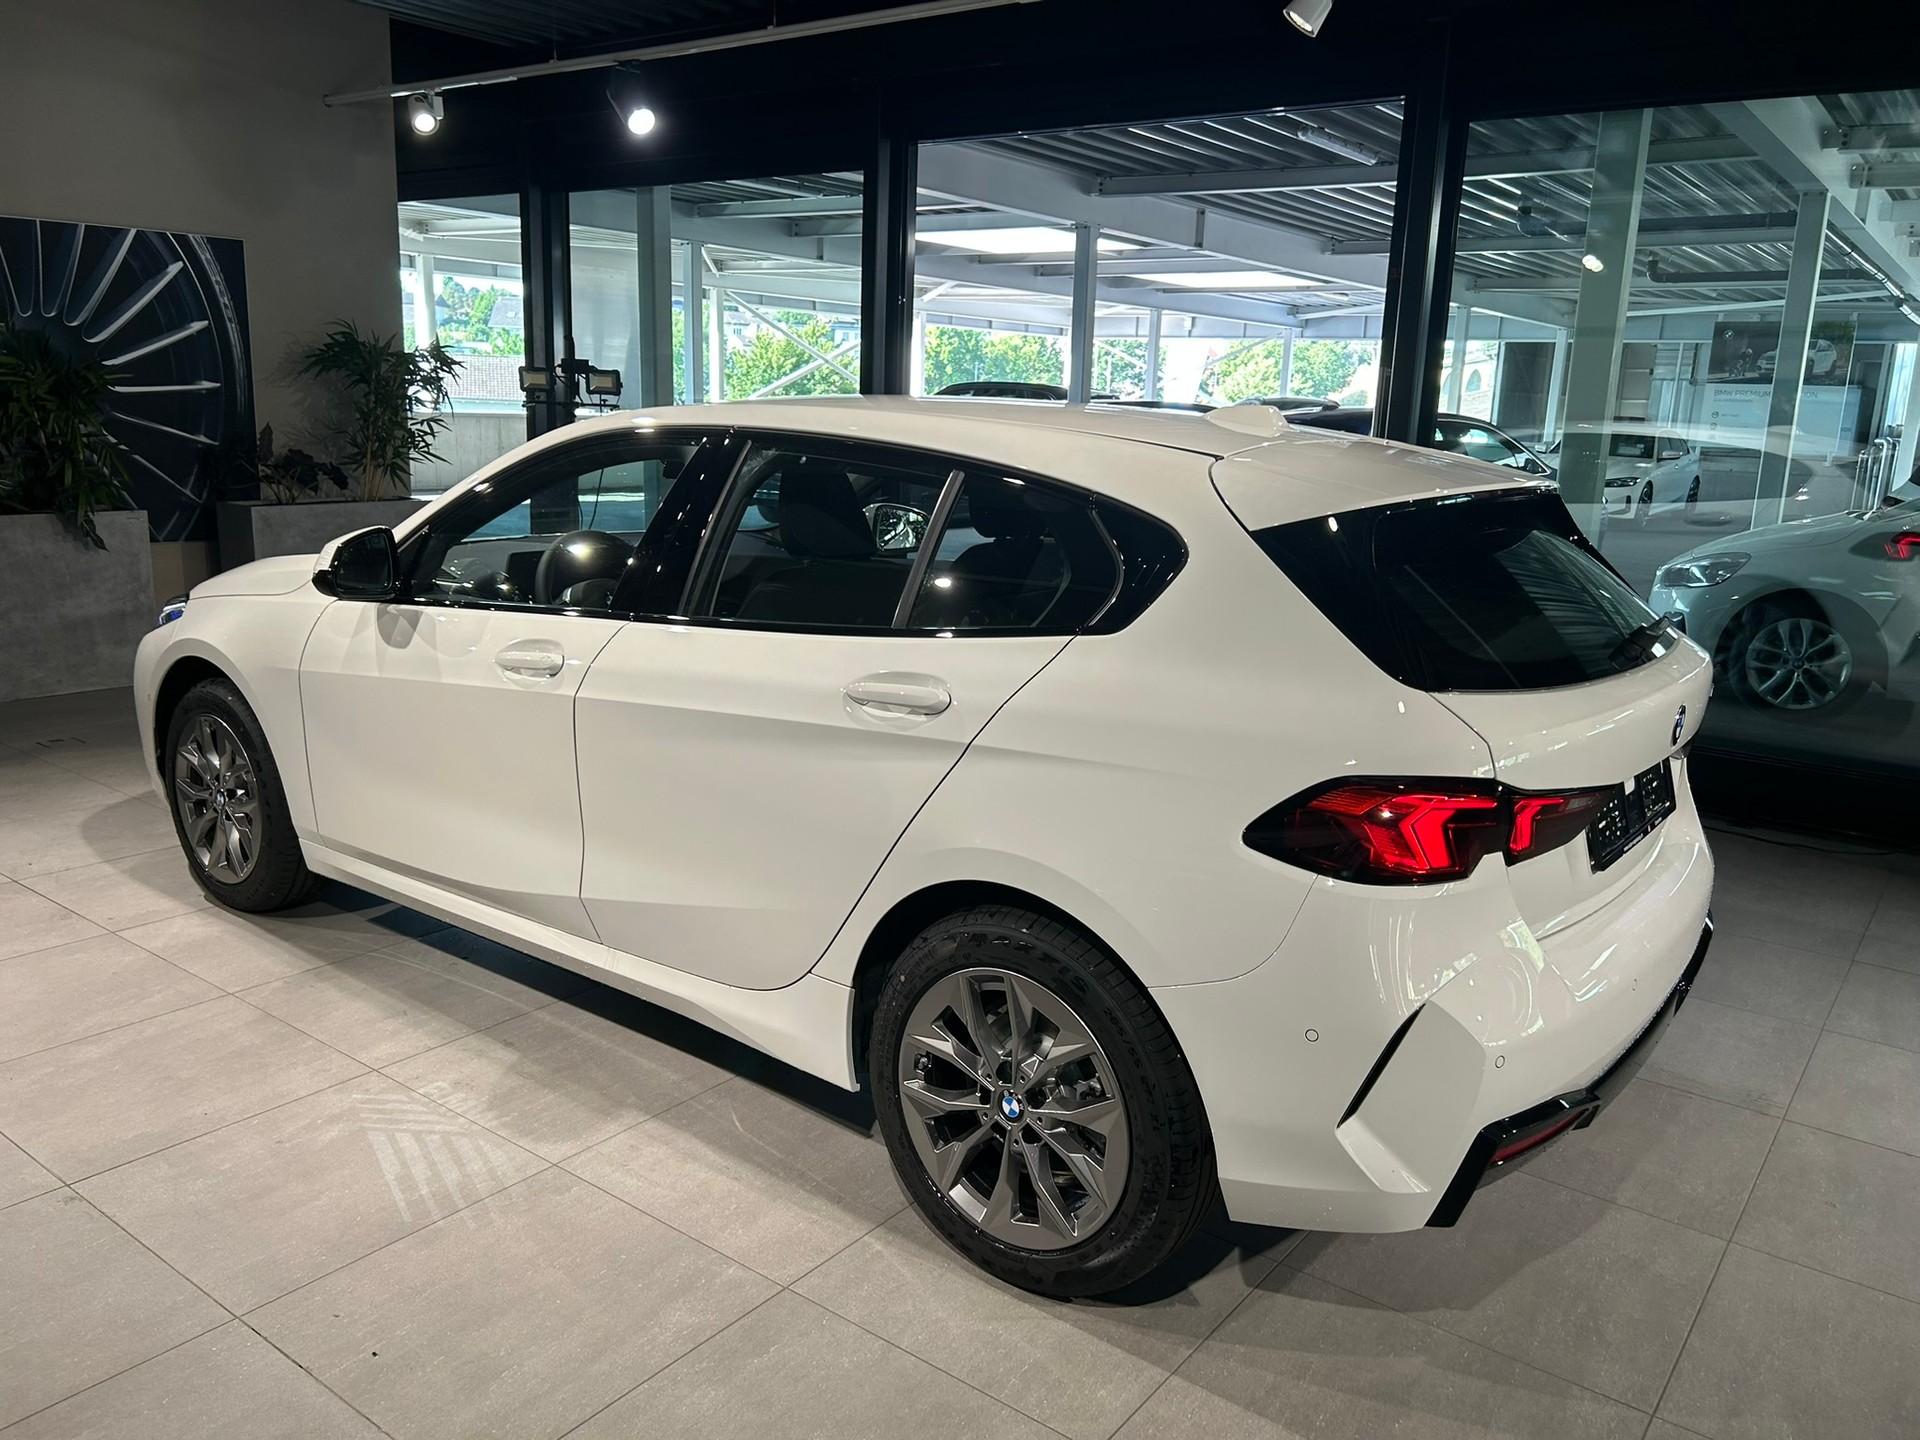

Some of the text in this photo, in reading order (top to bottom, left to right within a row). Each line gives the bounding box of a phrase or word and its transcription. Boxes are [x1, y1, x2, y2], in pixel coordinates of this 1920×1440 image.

[1713, 389, 1771, 398] BMW PREMIUM
[1003, 1089, 1025, 1110] BMW
